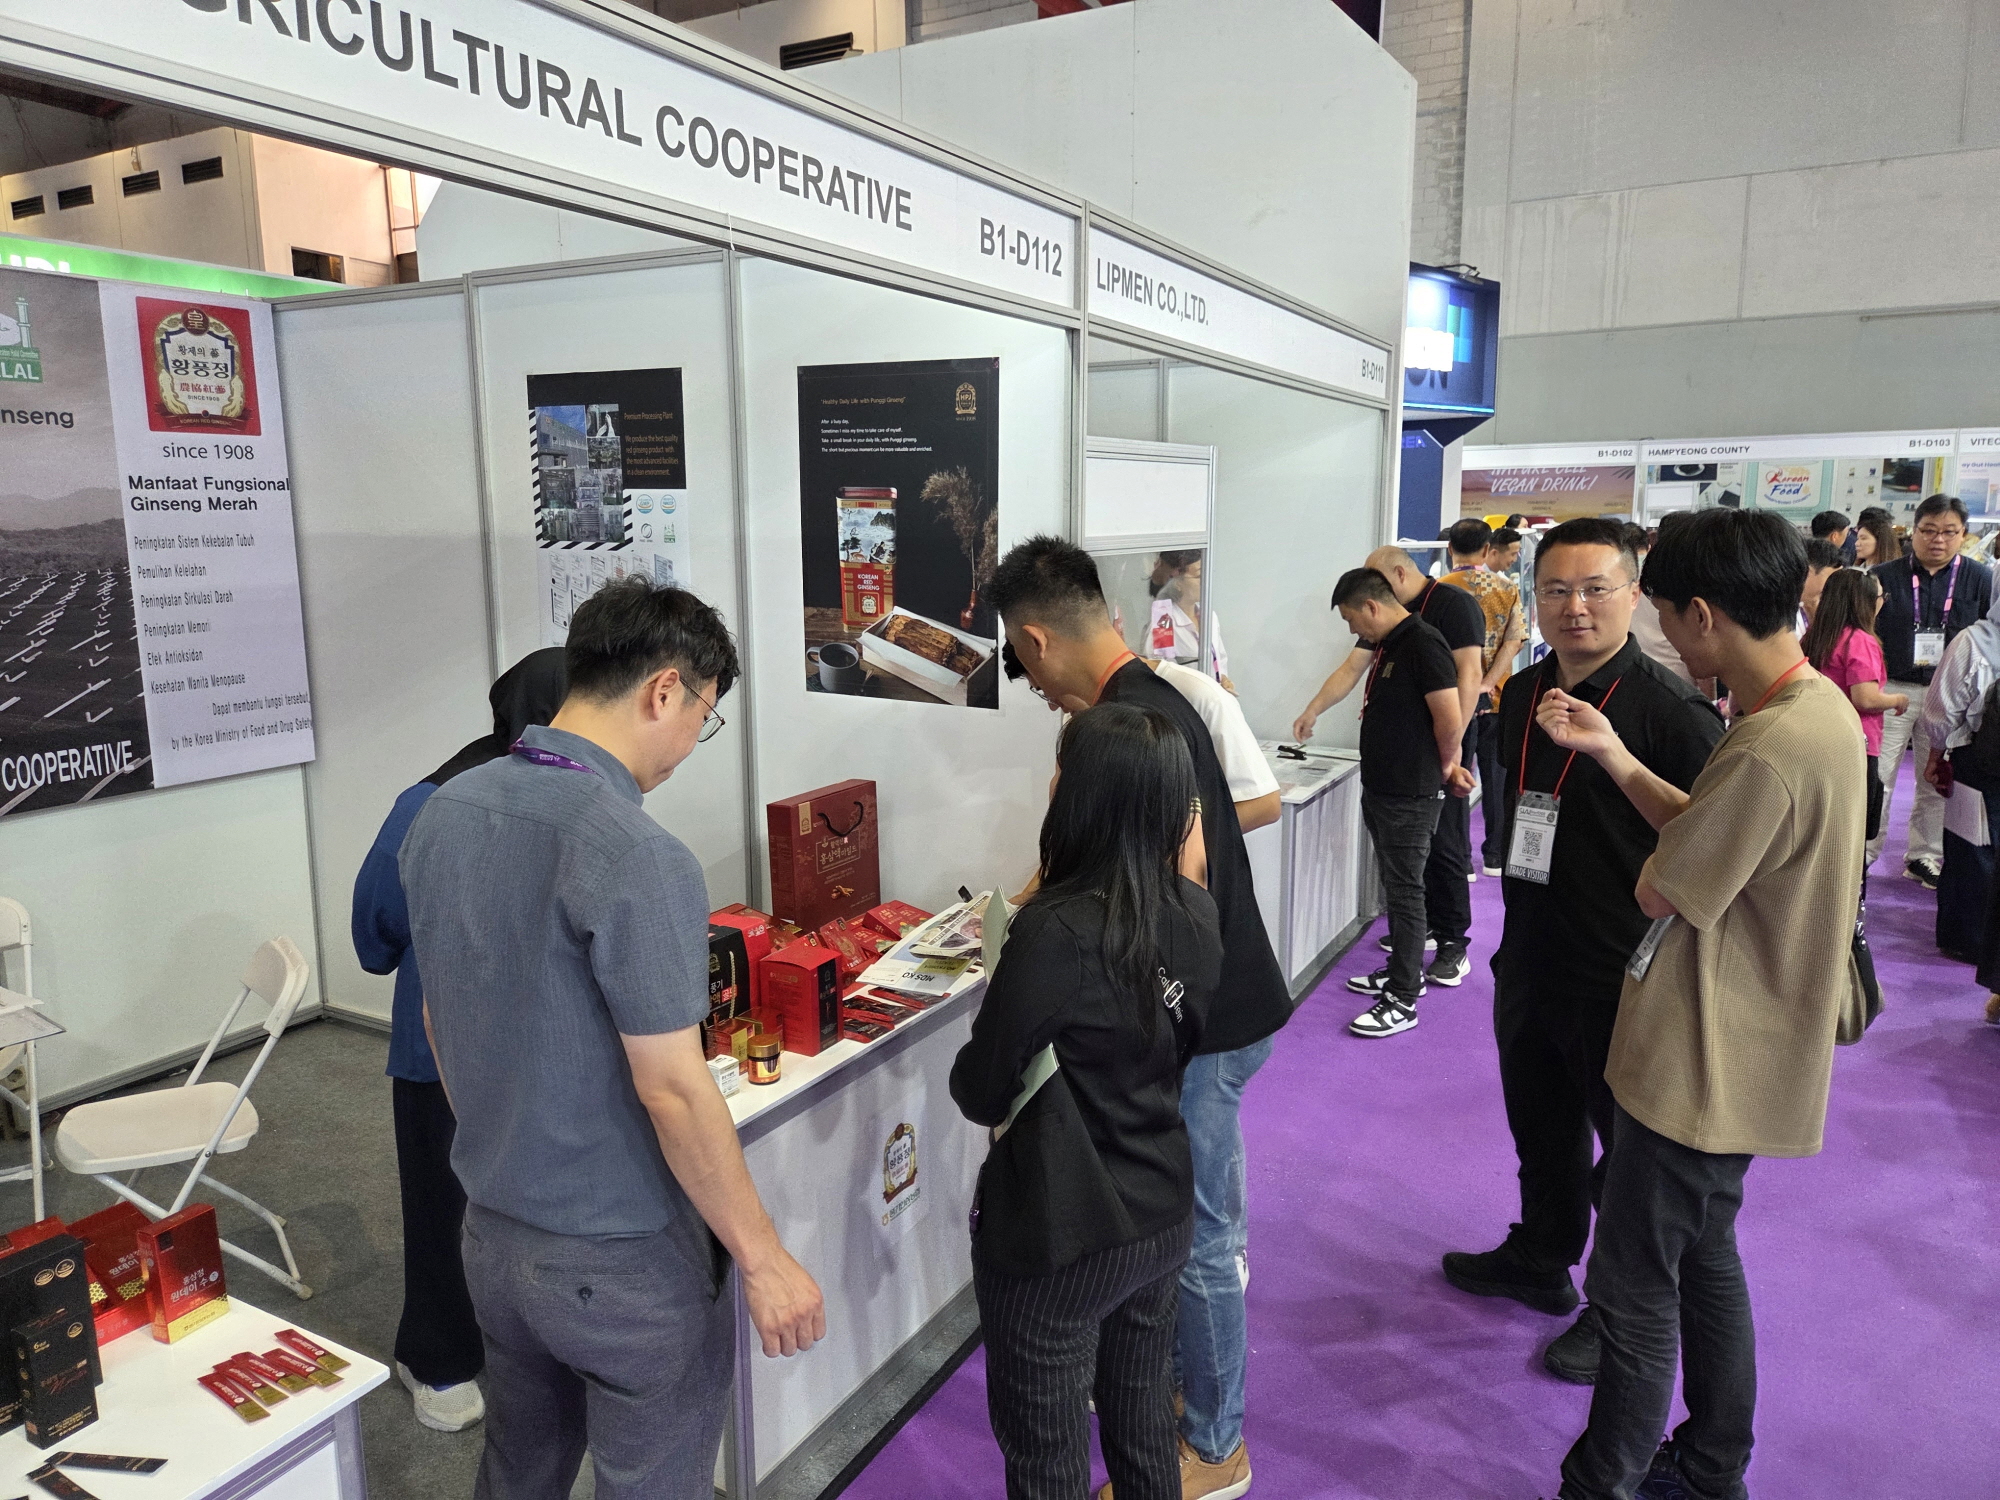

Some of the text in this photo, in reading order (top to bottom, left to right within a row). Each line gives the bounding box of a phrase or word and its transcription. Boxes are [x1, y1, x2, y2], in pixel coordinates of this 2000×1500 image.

[193, 0, 912, 231] RICULTURAL COOPERATIVE
[981, 217, 1062, 277] B1-D112
[1097, 258, 1153, 306] LIPMEN
[0, 362, 39, 379] LAL
[171, 359, 229, 378] 황풍정
[1362, 359, 1384, 383] B1-D110
[624, 412, 641, 420] Premium
[642, 412, 662, 421] Processing
[163, 443, 255, 459] since 1908
[1648, 445, 1750, 457] HAMPYEONG COUNTY
[1909, 438, 1951, 448] B1-D103
[1598, 449, 1633, 458] B1-D102
[128, 475, 290, 492] Manfaat Fungsional
[1490, 477, 1540, 495] VEGAN
[131, 496, 258, 513] Ginseng Merah
[134, 533, 255, 551] Peningkatan Sistem Kekebalan Tubuh
[137, 563, 207, 579] Pemulihan Kelelahan
[141, 590, 234, 609] Peningkatan Sirkulasi Darah
[144, 620, 211, 638] Peningkatan Memori
[165, 648, 203, 663] Antioksidan
[150, 673, 246, 694] Kesehatan Wanita Menopause
[212, 701, 231, 717] Dapat
[233, 698, 263, 713] membantu
[265, 694, 283, 709] fungsi
[171, 737, 179, 751] by
[182, 735, 193, 748] the
[195, 733, 213, 746] Korea
[215, 729, 240, 742] Ministry
[242, 726, 248, 739] of
[250, 723, 265, 737] Food
[267, 721, 278, 734] and
[280, 720, 293, 733] Drug
[2, 740, 135, 792] COOPERATIVE
[1509, 865, 1548, 881] TRADE VISITOR
[1174, 1000, 1184, 1023] lein
